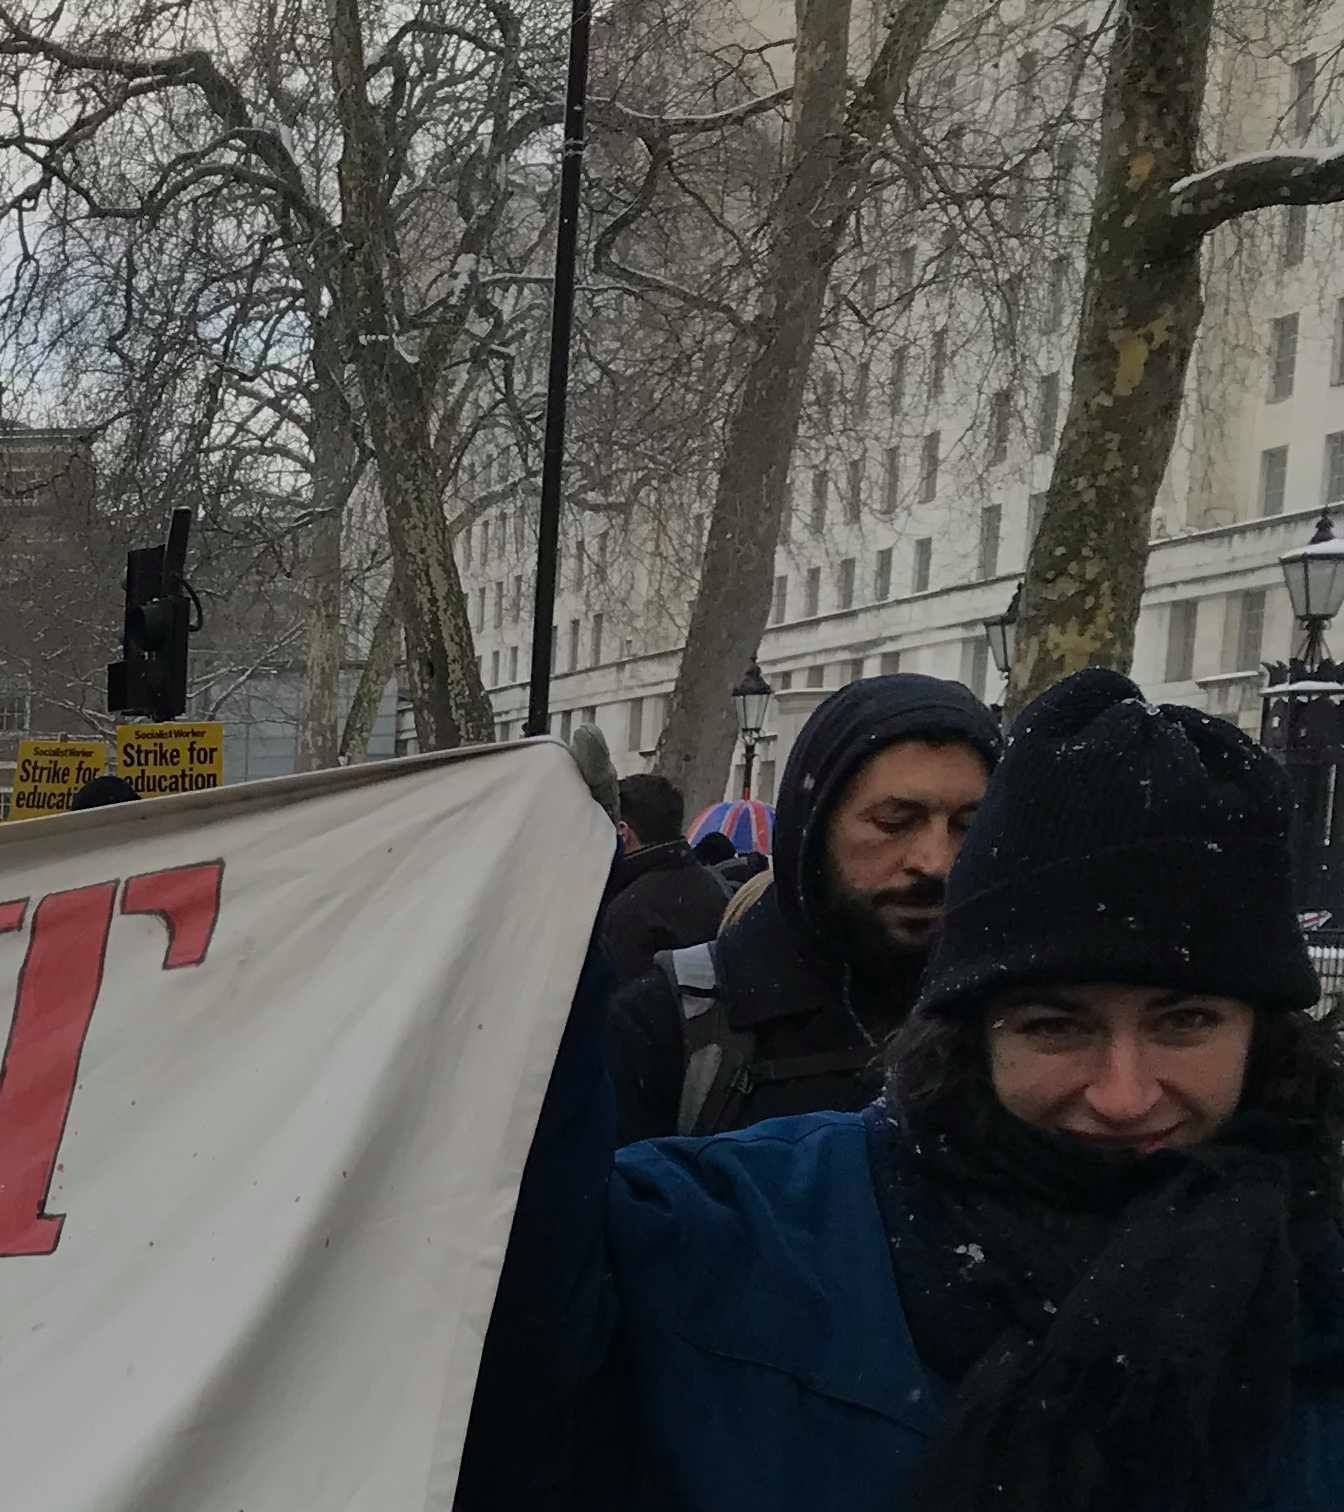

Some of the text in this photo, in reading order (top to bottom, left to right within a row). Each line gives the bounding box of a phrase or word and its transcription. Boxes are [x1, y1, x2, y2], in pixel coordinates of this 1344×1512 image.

[134, 728, 207, 740] Socialist Worker
[122, 739, 218, 768] Strike for
[19, 758, 101, 785] Strike for
[127, 766, 217, 794] education
[15, 785, 79, 810] educati
